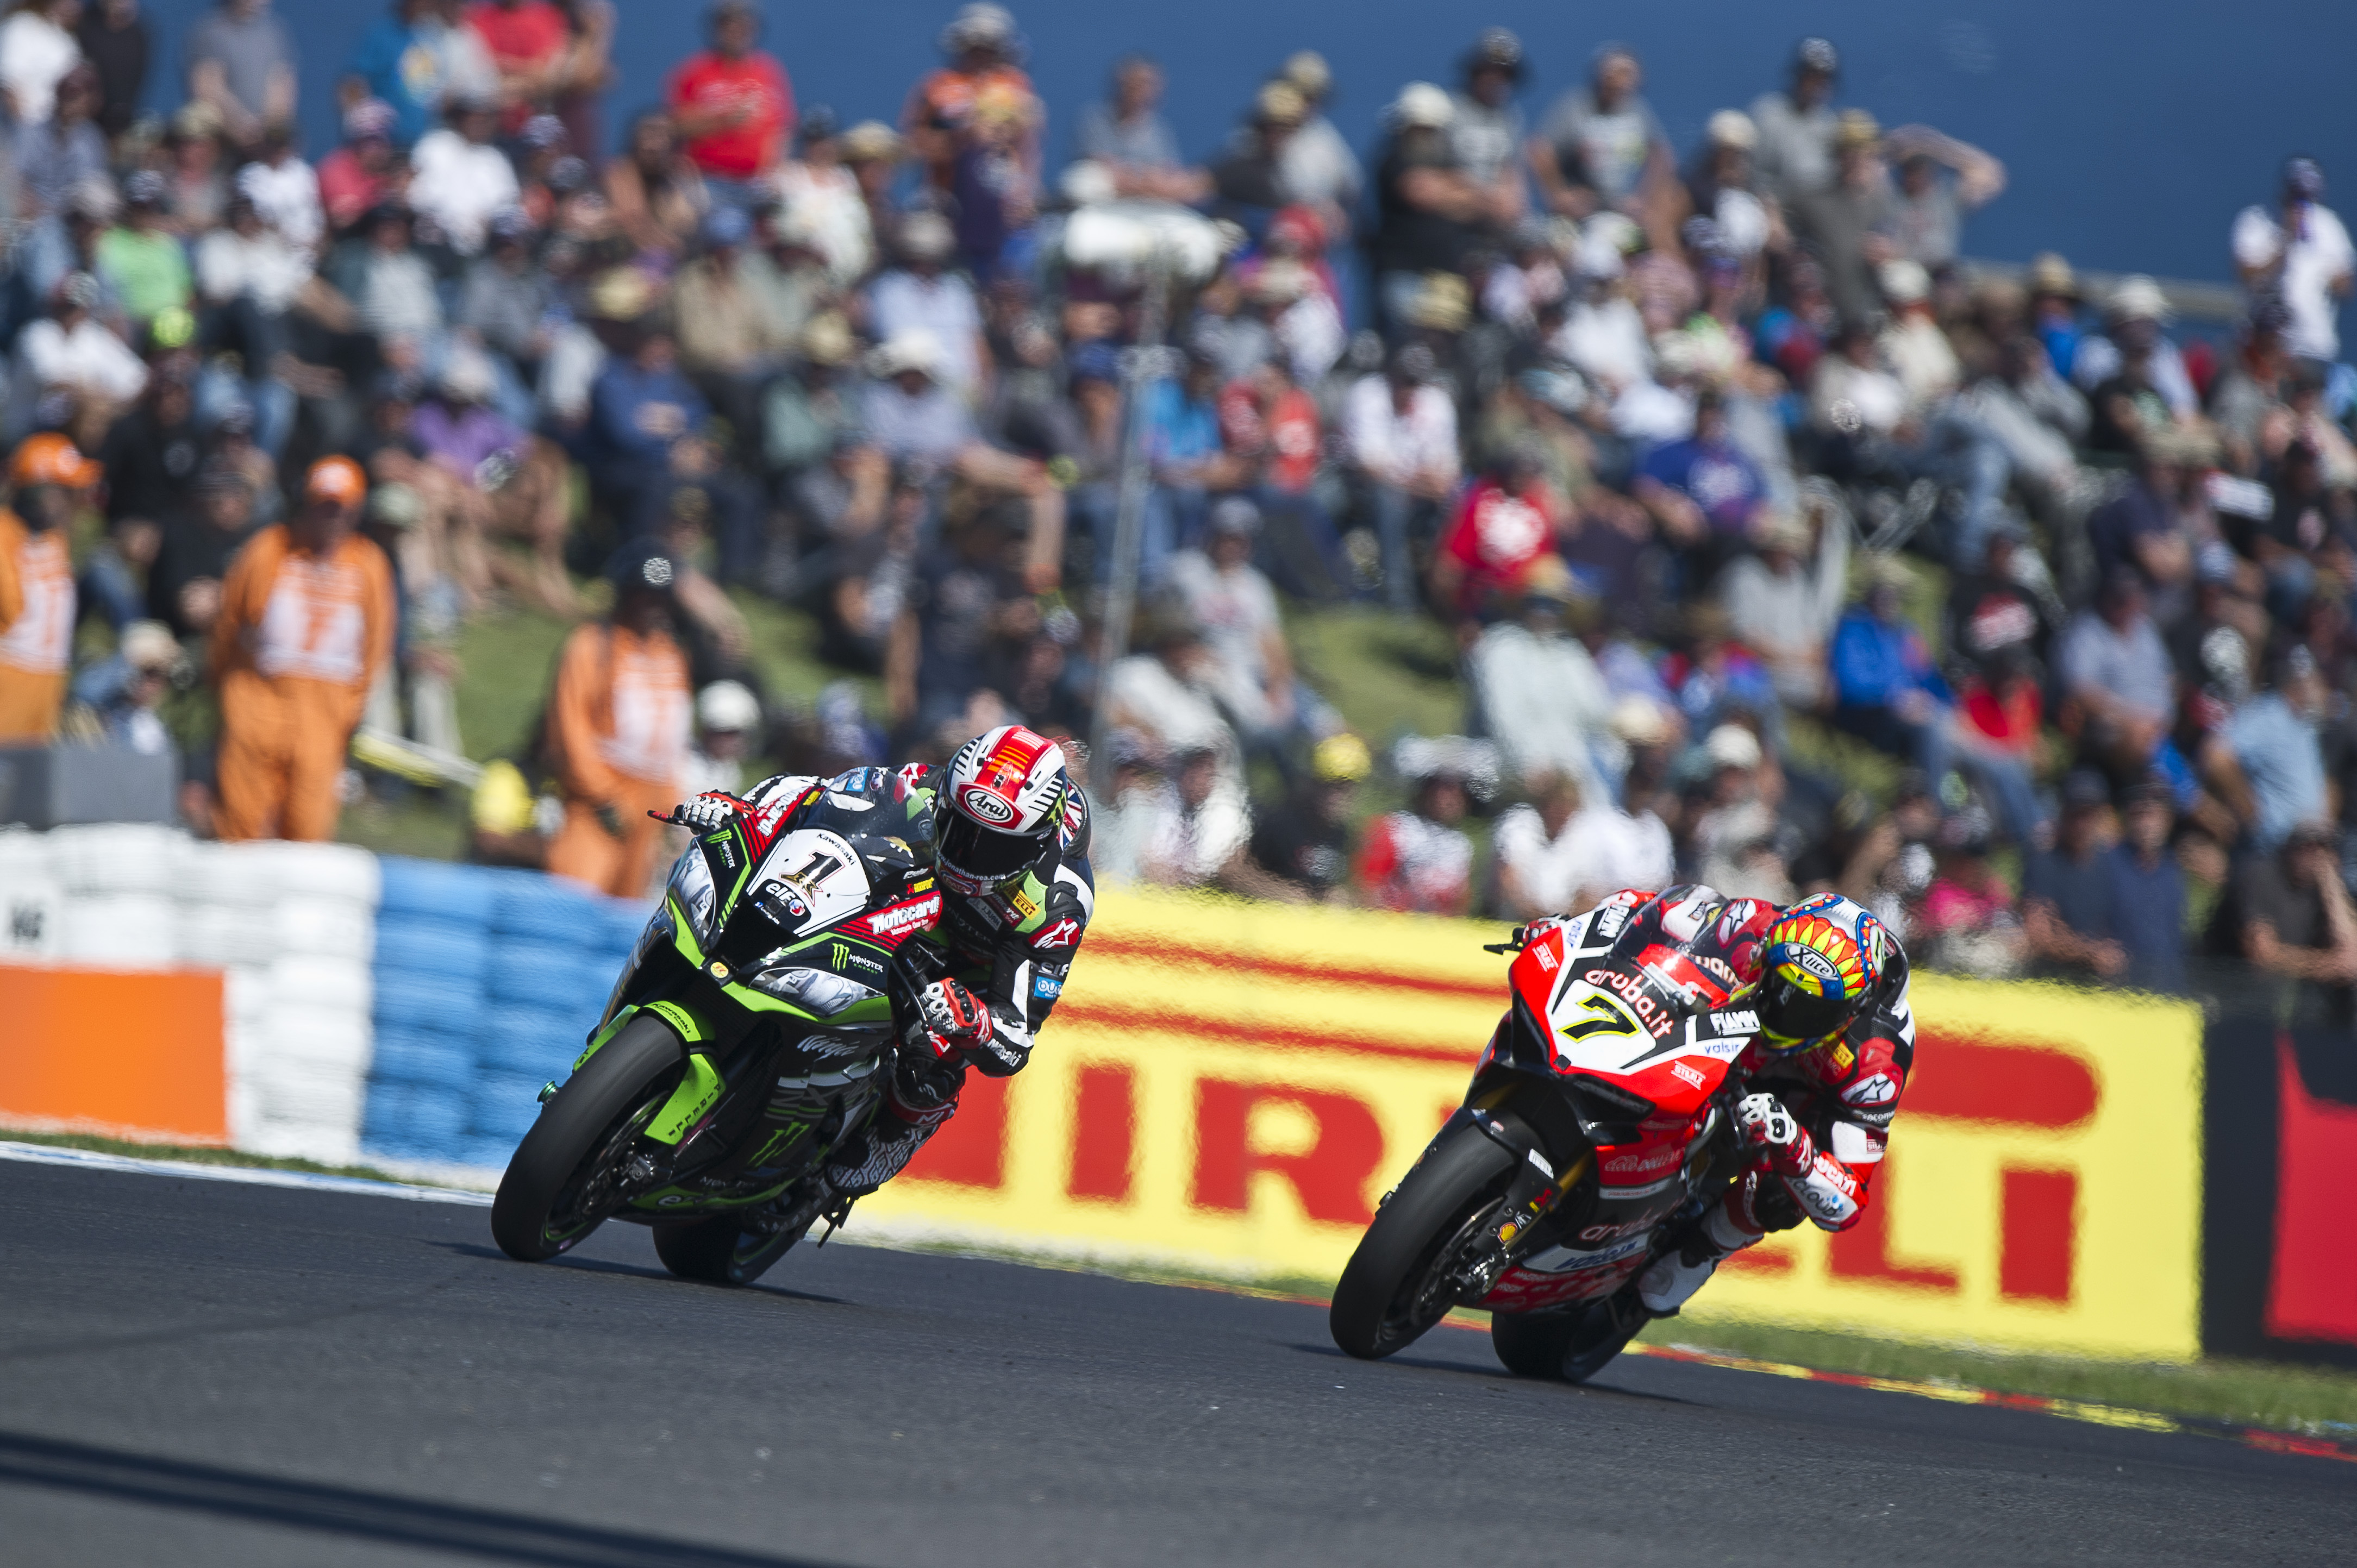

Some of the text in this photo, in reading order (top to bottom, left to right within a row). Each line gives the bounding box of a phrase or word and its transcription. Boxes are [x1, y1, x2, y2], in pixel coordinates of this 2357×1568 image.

[968, 794, 1009, 817] Arai
[816, 832, 856, 865] Kawasaki
[766, 882, 796, 902] elf
[779, 849, 846, 907] 1
[867, 896, 940, 934] Motocard
[848, 953, 883, 973] MONSTER
[1041, 962, 1069, 976] elf
[1790, 948, 1830, 975] X-lite
[1585, 969, 1674, 1038] aruba.it
[652, 1003, 691, 1033] Kawasaki
[1556, 992, 1641, 1044] 7
[1709, 1010, 1761, 1036] FIAMM
[1705, 1042, 1740, 1055] valsir
[668, 1084, 722, 1137] PIRELLI
